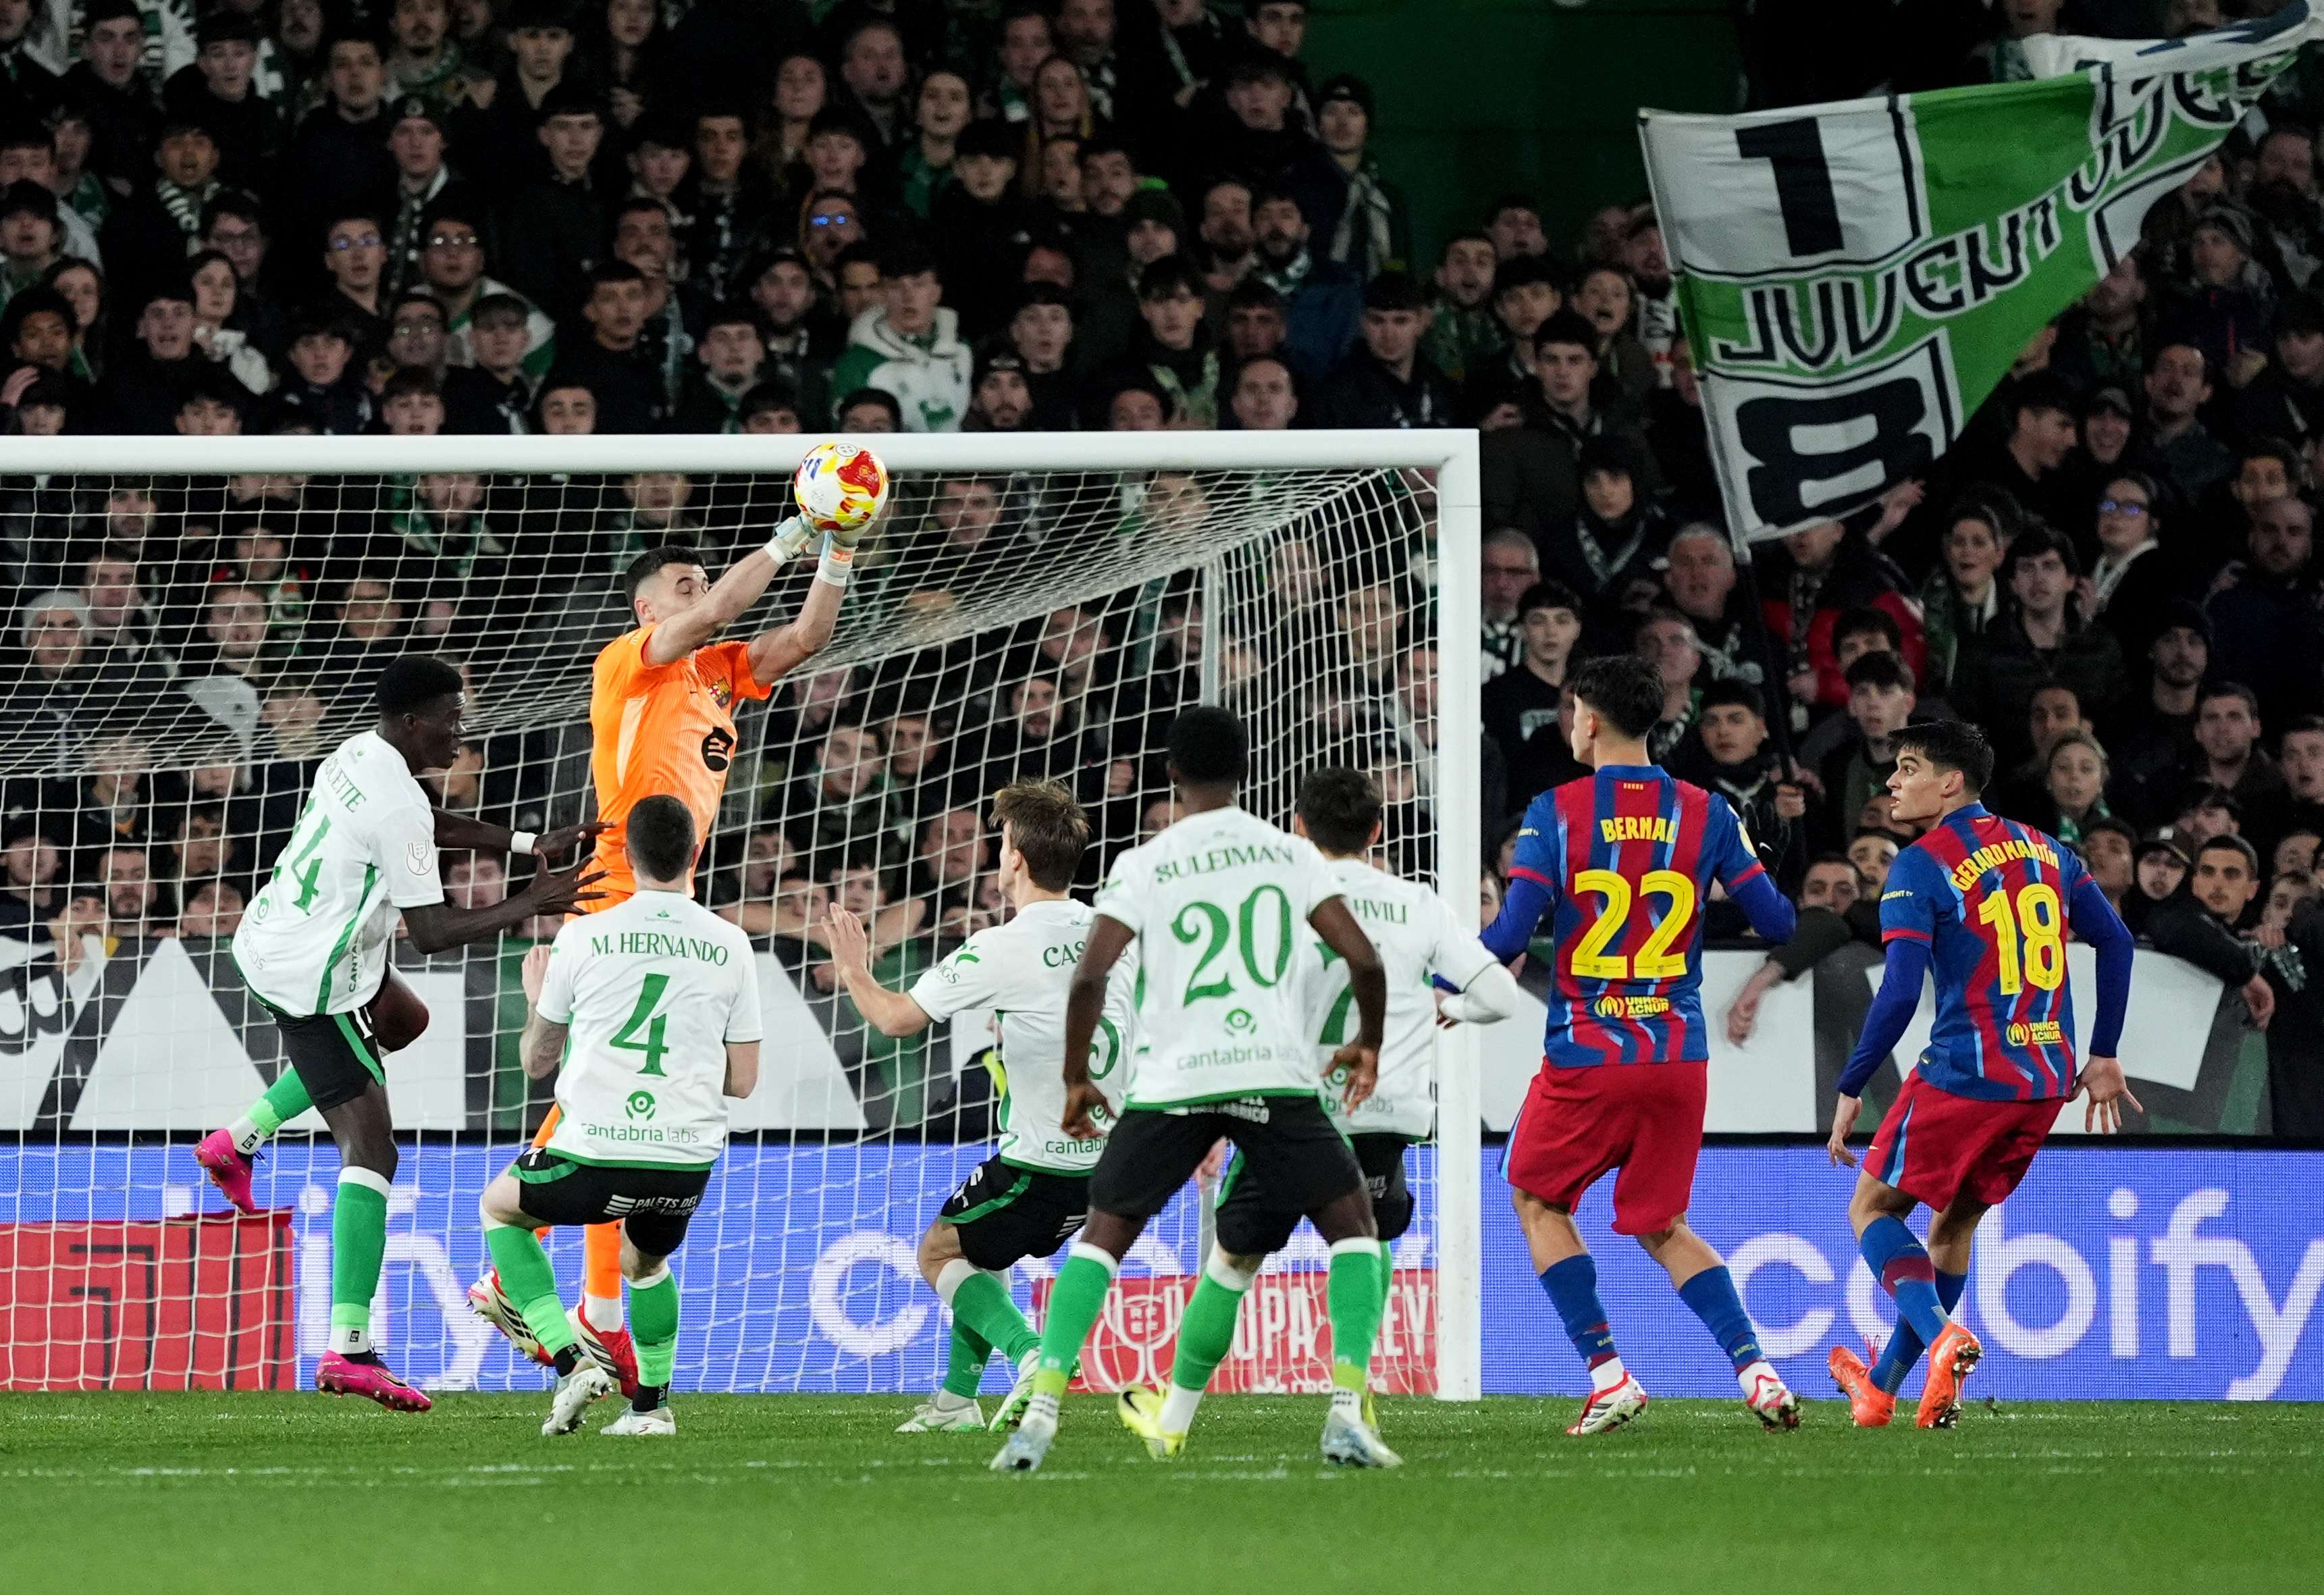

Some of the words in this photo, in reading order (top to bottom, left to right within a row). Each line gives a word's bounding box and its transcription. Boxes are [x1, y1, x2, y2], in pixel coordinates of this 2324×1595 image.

[1735, 117, 1845, 258] 1
[1735, 375, 1935, 528] 8
[1600, 816, 1678, 843] BERNAL
[1155, 845, 1294, 884] SULEIMAN
[1950, 843, 2007, 891] GERARD
[1353, 899, 1407, 925] HVILI
[1570, 868, 1695, 979] 22
[591, 935, 614, 958] M.
[619, 932, 729, 966] HERNANDO
[1169, 884, 1293, 1009] 20
[1977, 883, 2065, 996] 18
[609, 972, 670, 1078] 4
[1627, 1002, 1670, 1015] ACNUR
[2029, 1020, 2060, 1032] UNHCR
[2032, 1030, 2062, 1041] ACNUR
[1232, 1286, 1314, 1359] OPA
